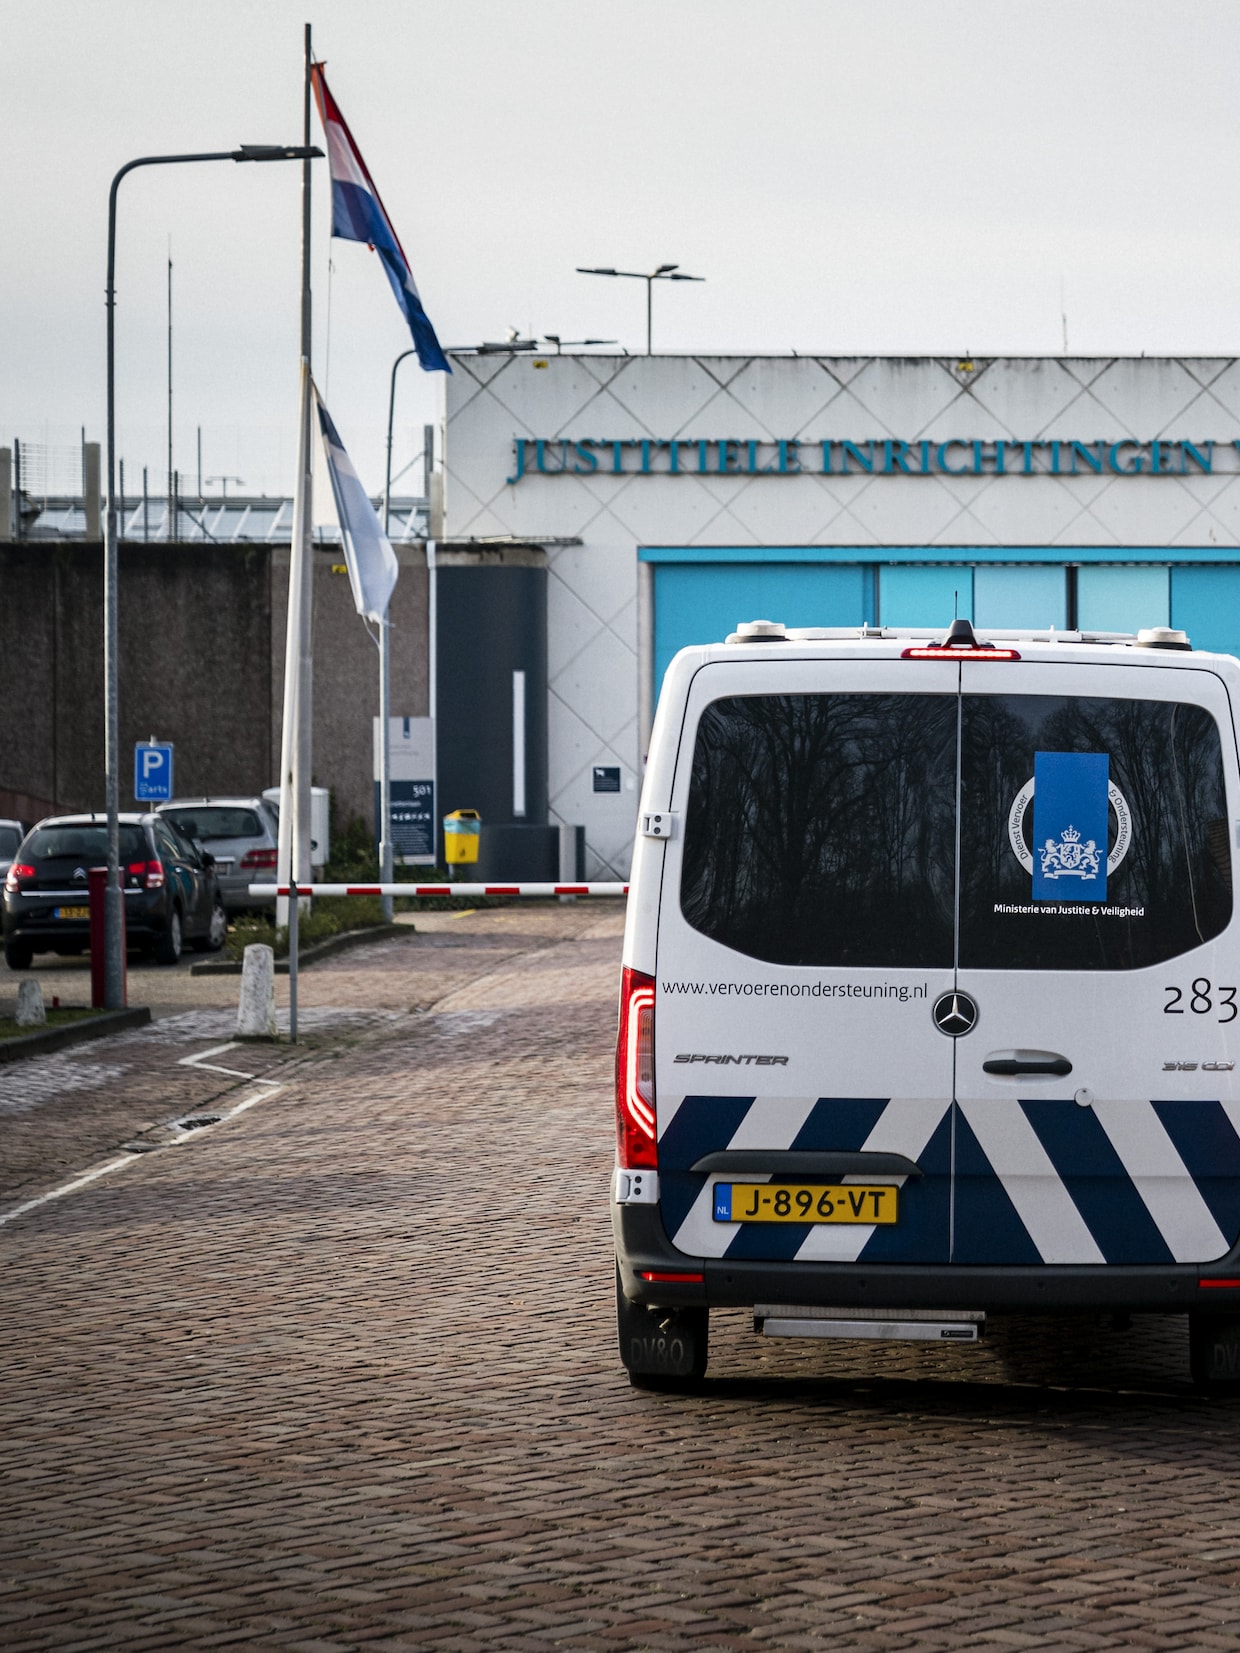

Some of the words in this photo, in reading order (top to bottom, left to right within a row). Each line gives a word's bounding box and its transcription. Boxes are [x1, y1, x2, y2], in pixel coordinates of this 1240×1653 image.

[506, 438, 801, 485] JUSTITIELE
[819, 438, 1216, 476] INRICHTINGEN
[143, 751, 164, 779] P
[1109, 789, 1117, 798] &
[1011, 794, 1028, 829] Vervoer
[1109, 797, 1128, 864] Ondersteuning
[1012, 830, 1029, 861] Dienst
[993, 904, 1039, 914] Ministerie
[1040, 906, 1057, 914] van
[1058, 905, 1091, 915] Justitie
[1091, 906, 1100, 915] &
[1100, 906, 1145, 918] Veiligheid
[662, 981, 928, 1002] www.vervoerenondersteuning.nl
[1163, 977, 1239, 1023] 283
[673, 1054, 790, 1066] SPRINTER
[716, 1206, 729, 1215] NL
[745, 1189, 886, 1217] J-896-VT
